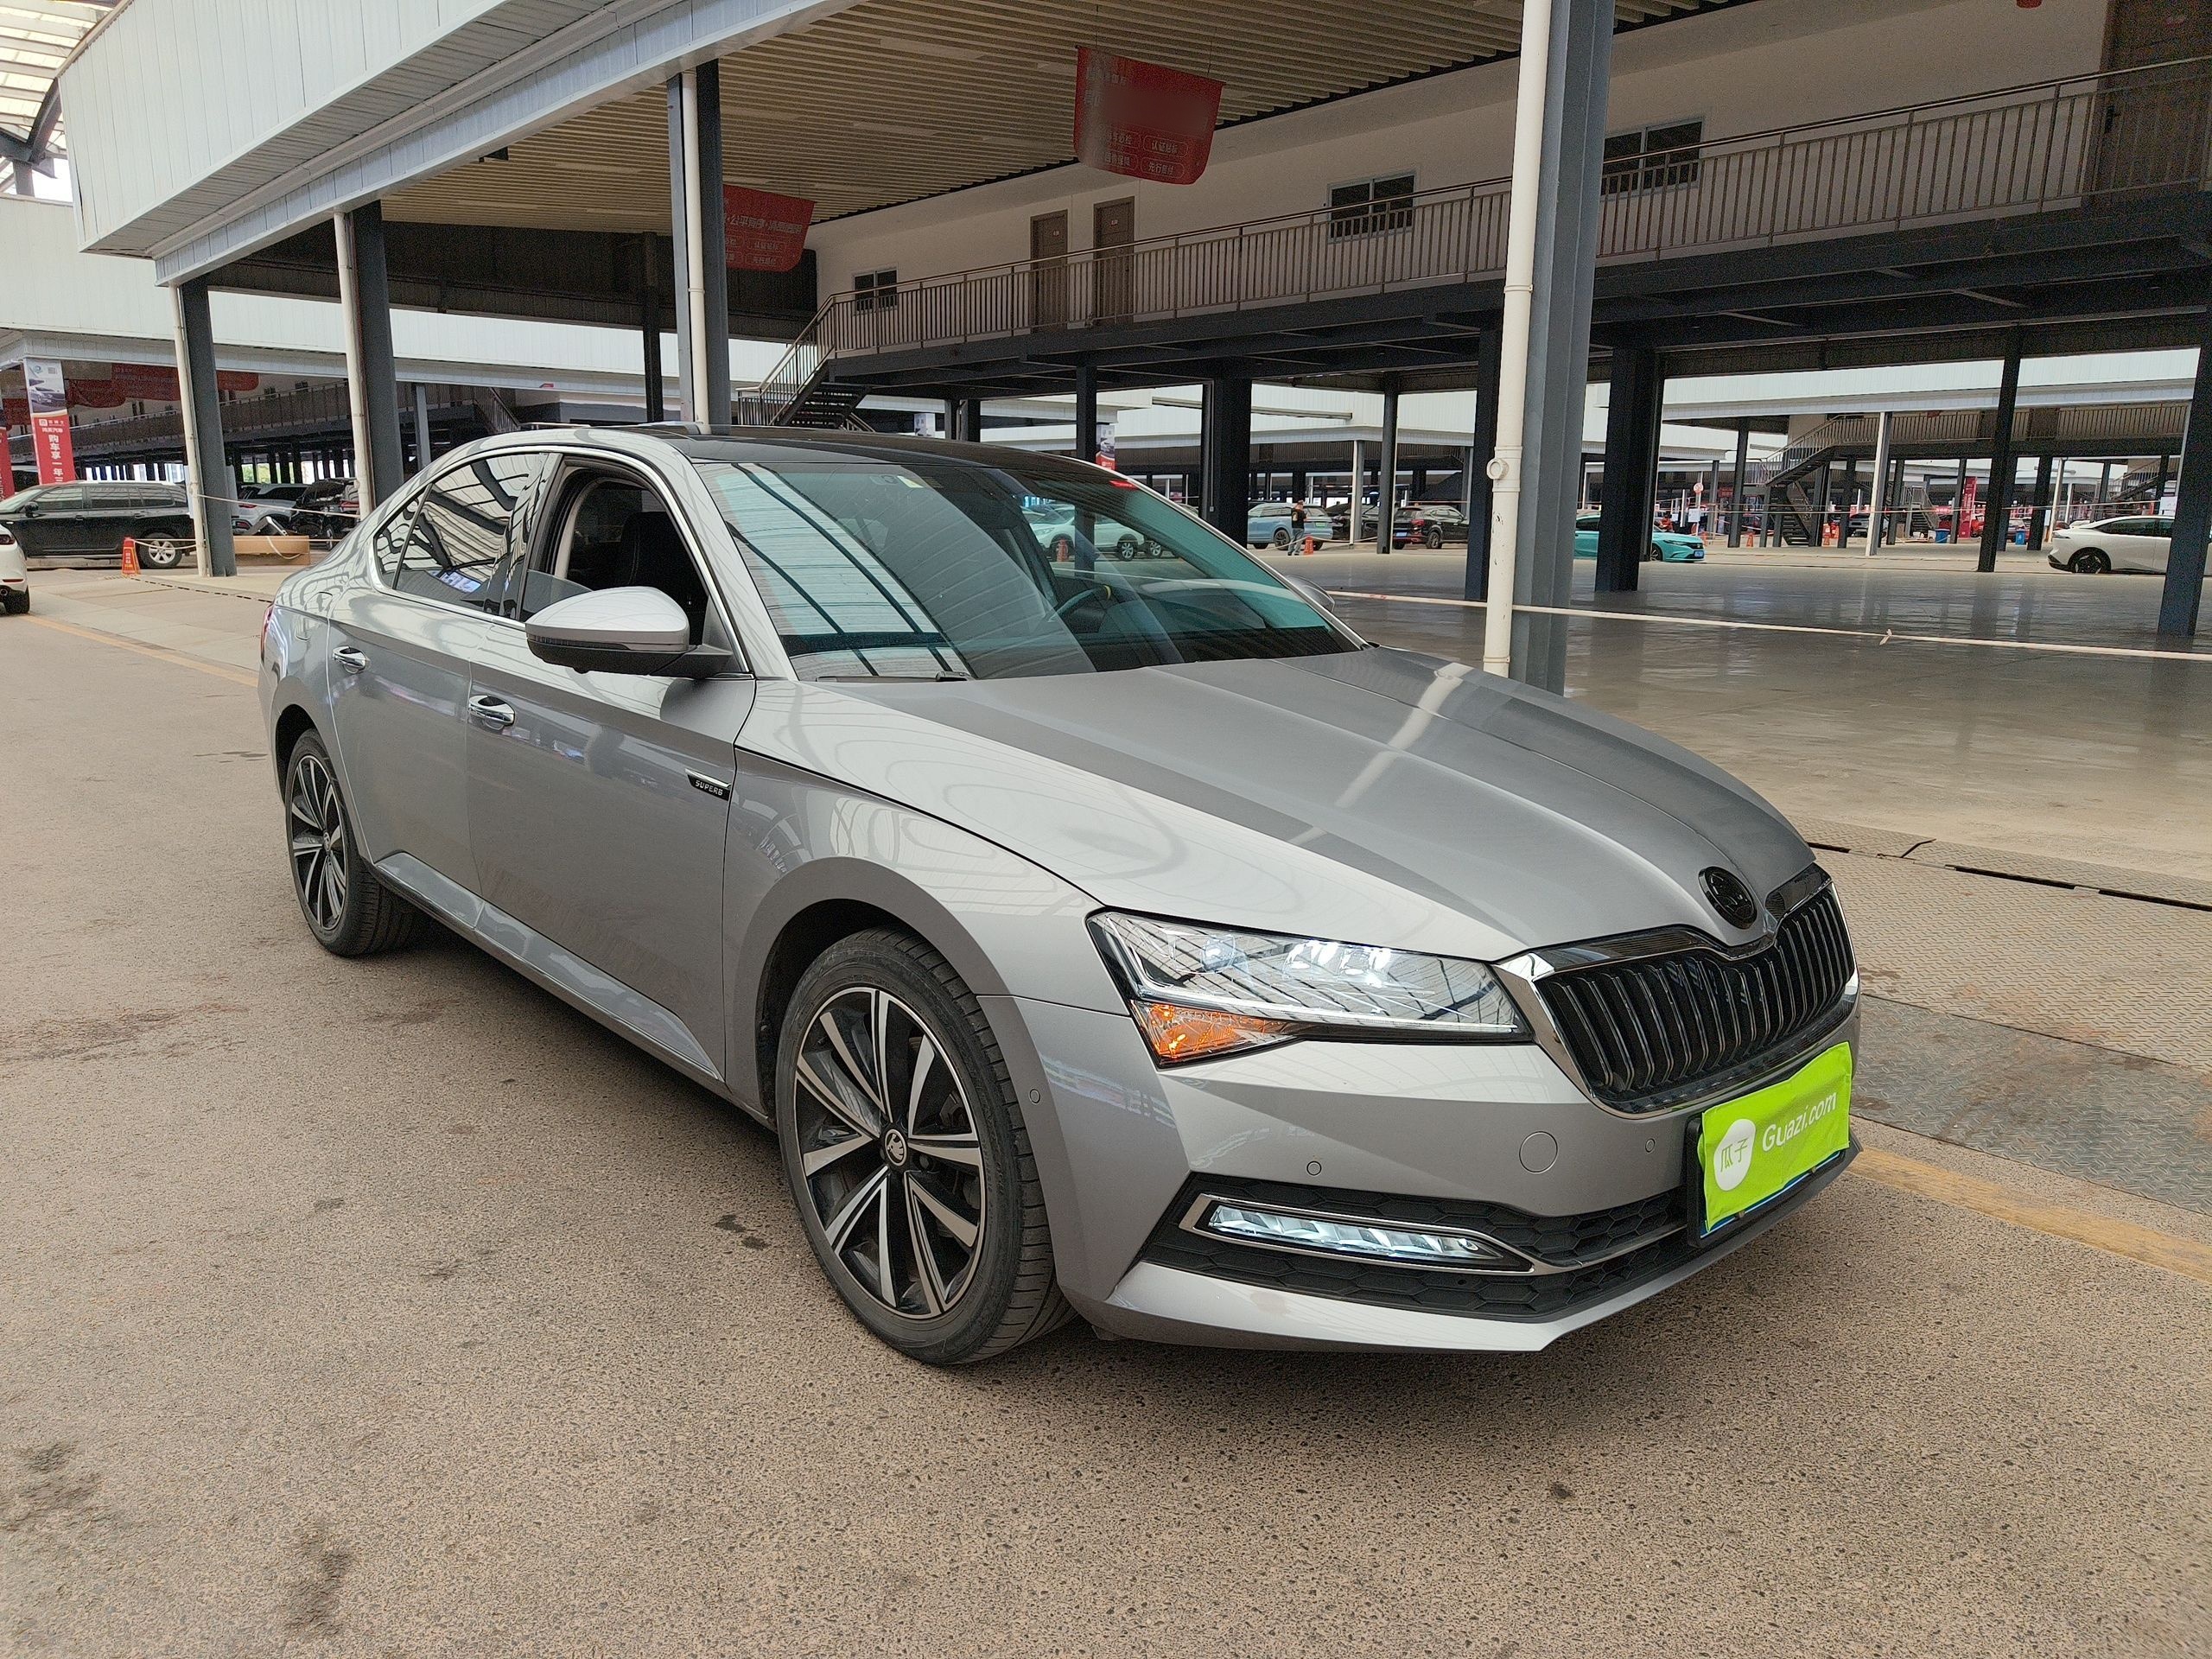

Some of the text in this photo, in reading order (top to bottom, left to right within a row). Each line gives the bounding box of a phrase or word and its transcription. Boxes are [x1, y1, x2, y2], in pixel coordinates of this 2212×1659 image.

[695, 779, 723, 796] SUPERB
[1762, 1091, 1838, 1152] Guazi.com
[1719, 1136, 1750, 1173] 瓜子
